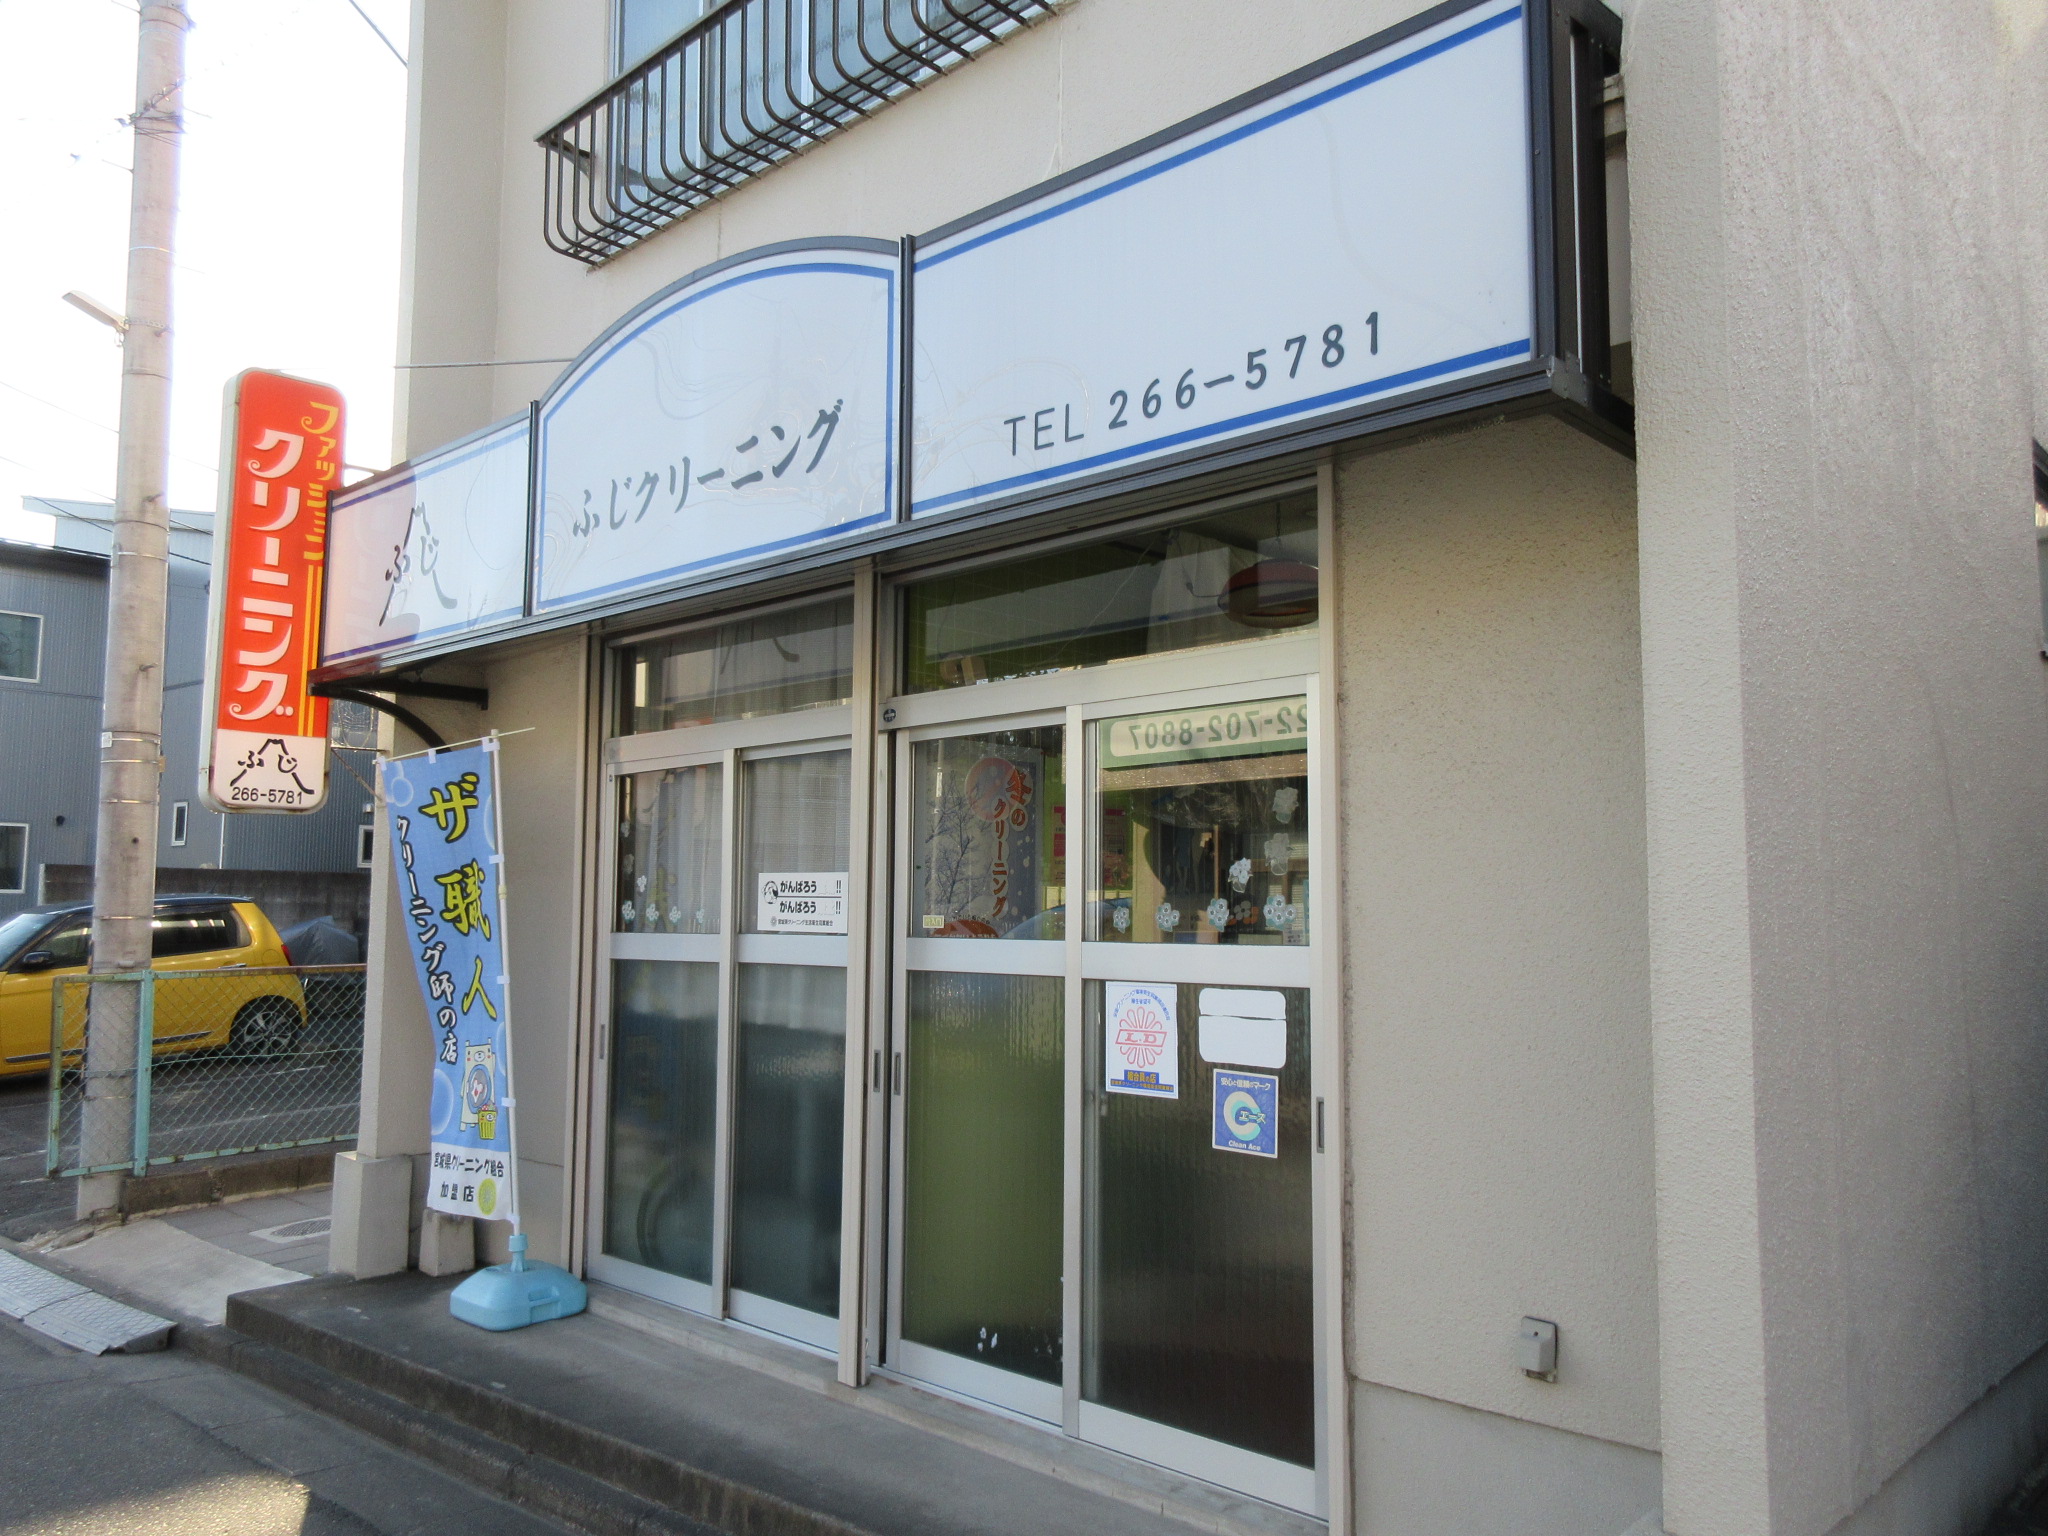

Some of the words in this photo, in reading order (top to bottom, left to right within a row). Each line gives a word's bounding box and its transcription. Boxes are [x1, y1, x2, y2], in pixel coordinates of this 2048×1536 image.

[1003, 402, 1085, 456] TEL
[1108, 311, 1379, 430] 266-5781
[572, 398, 844, 538] ふじクリーニング
[228, 428, 305, 721] クリーニング
[231, 786, 304, 805] 266-5781
[1005, 768, 1033, 827] 冬の
[780, 880, 817, 893] がんばろう
[779, 901, 816, 914] がんばろう
[397, 815, 459, 1066] クリーニング師の店
[1238, 1110, 1266, 1125] エース
[1228, 1139, 1247, 1149] Clean
[440, 1180, 475, 1202] 加盟店
